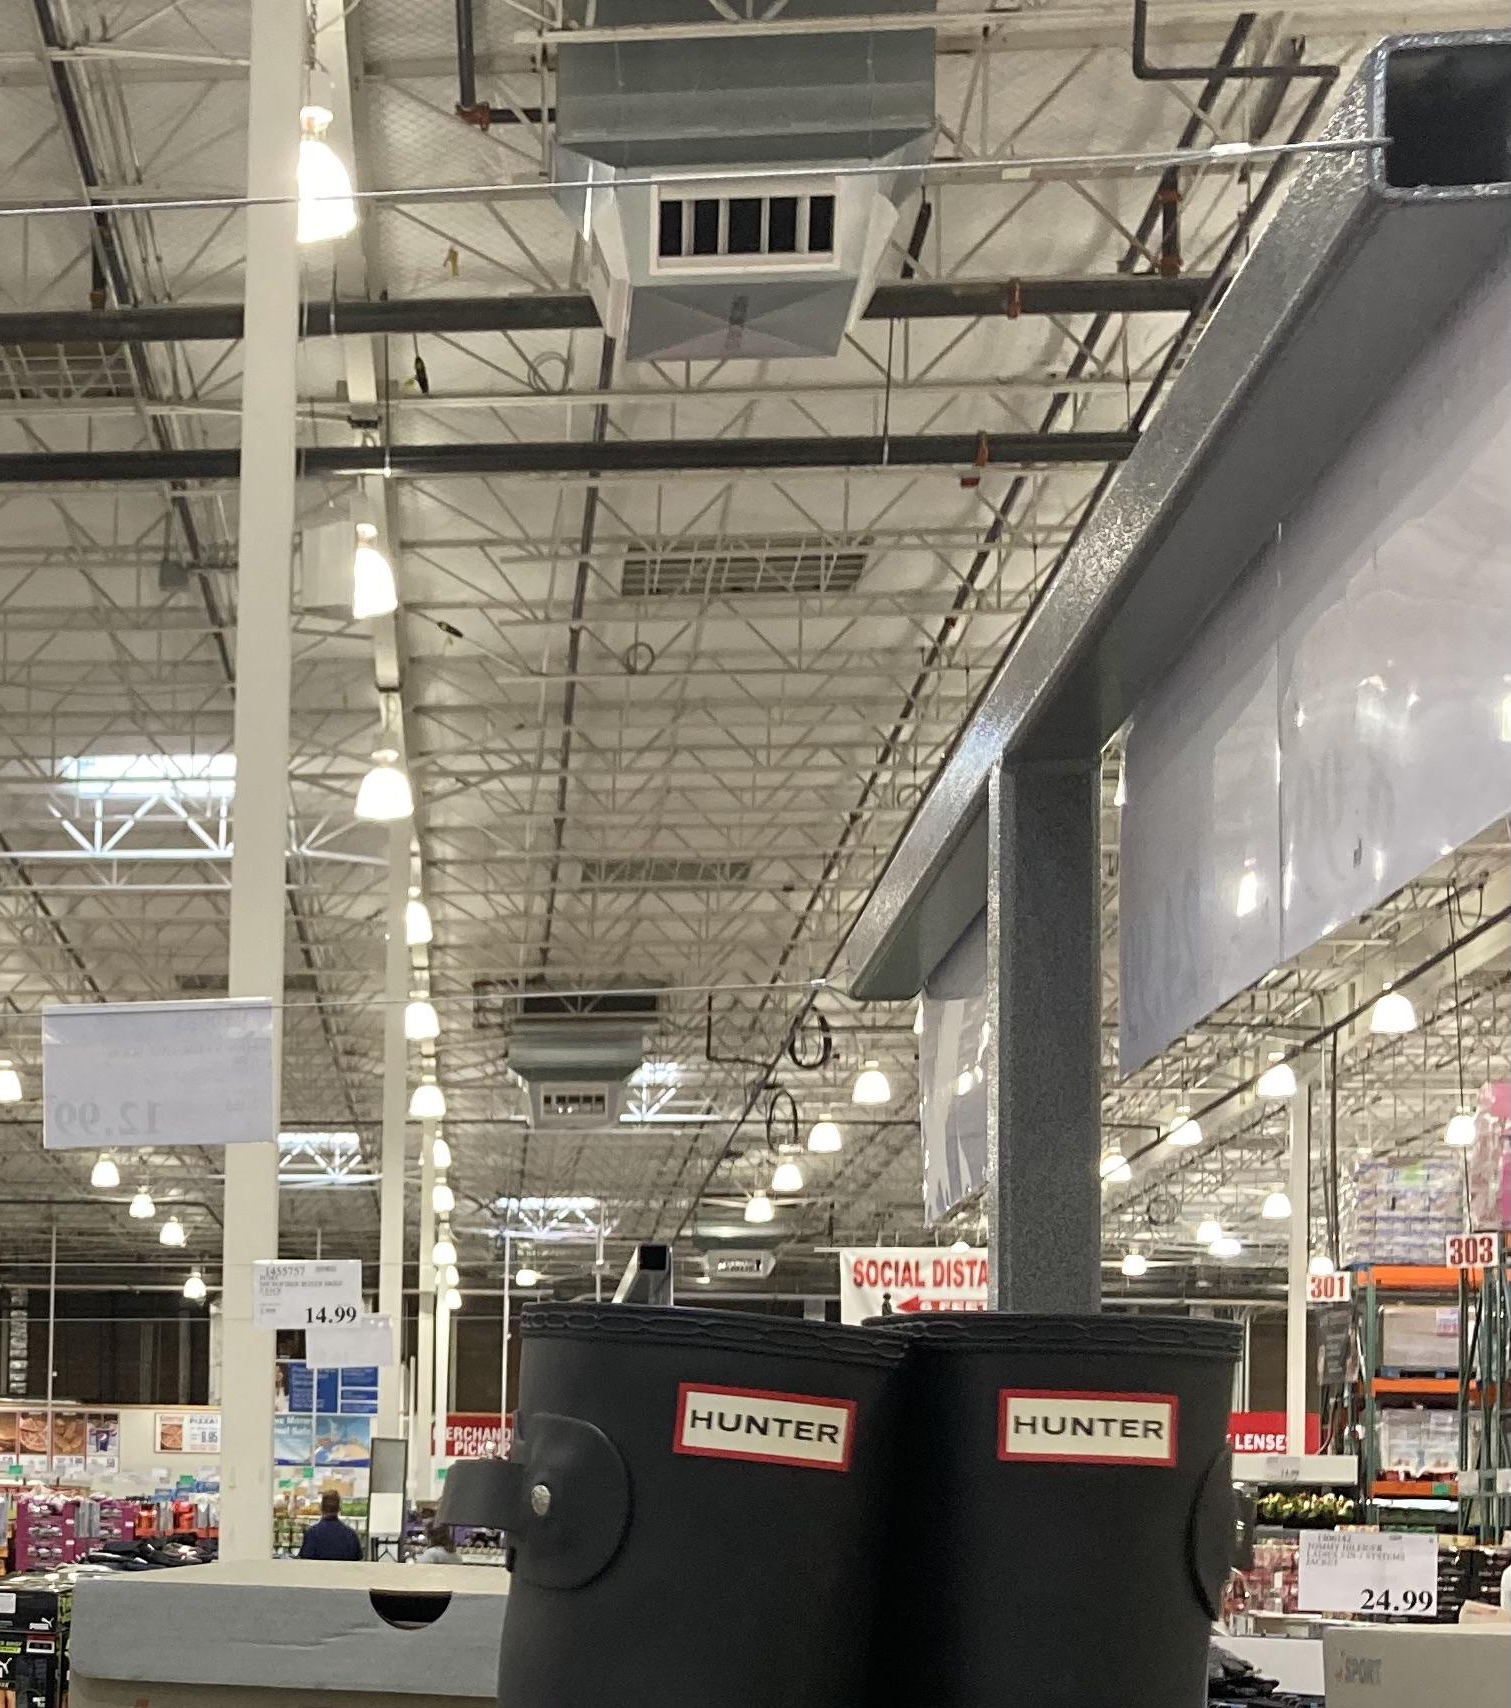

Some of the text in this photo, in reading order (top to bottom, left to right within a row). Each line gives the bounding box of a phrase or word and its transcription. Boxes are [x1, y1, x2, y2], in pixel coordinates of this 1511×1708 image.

[1449, 1237, 1493, 1265] 303
[853, 1259, 988, 1288] SOCIAL DISTA
[1310, 1275, 1346, 1299] 301
[306, 1306, 357, 1323] 14.99
[690, 1409, 840, 1445] HUNTER
[1013, 1414, 1165, 1441] HUNTER
[1235, 1433, 1287, 1451] LENSE
[1360, 1588, 1433, 1612] 24.99
